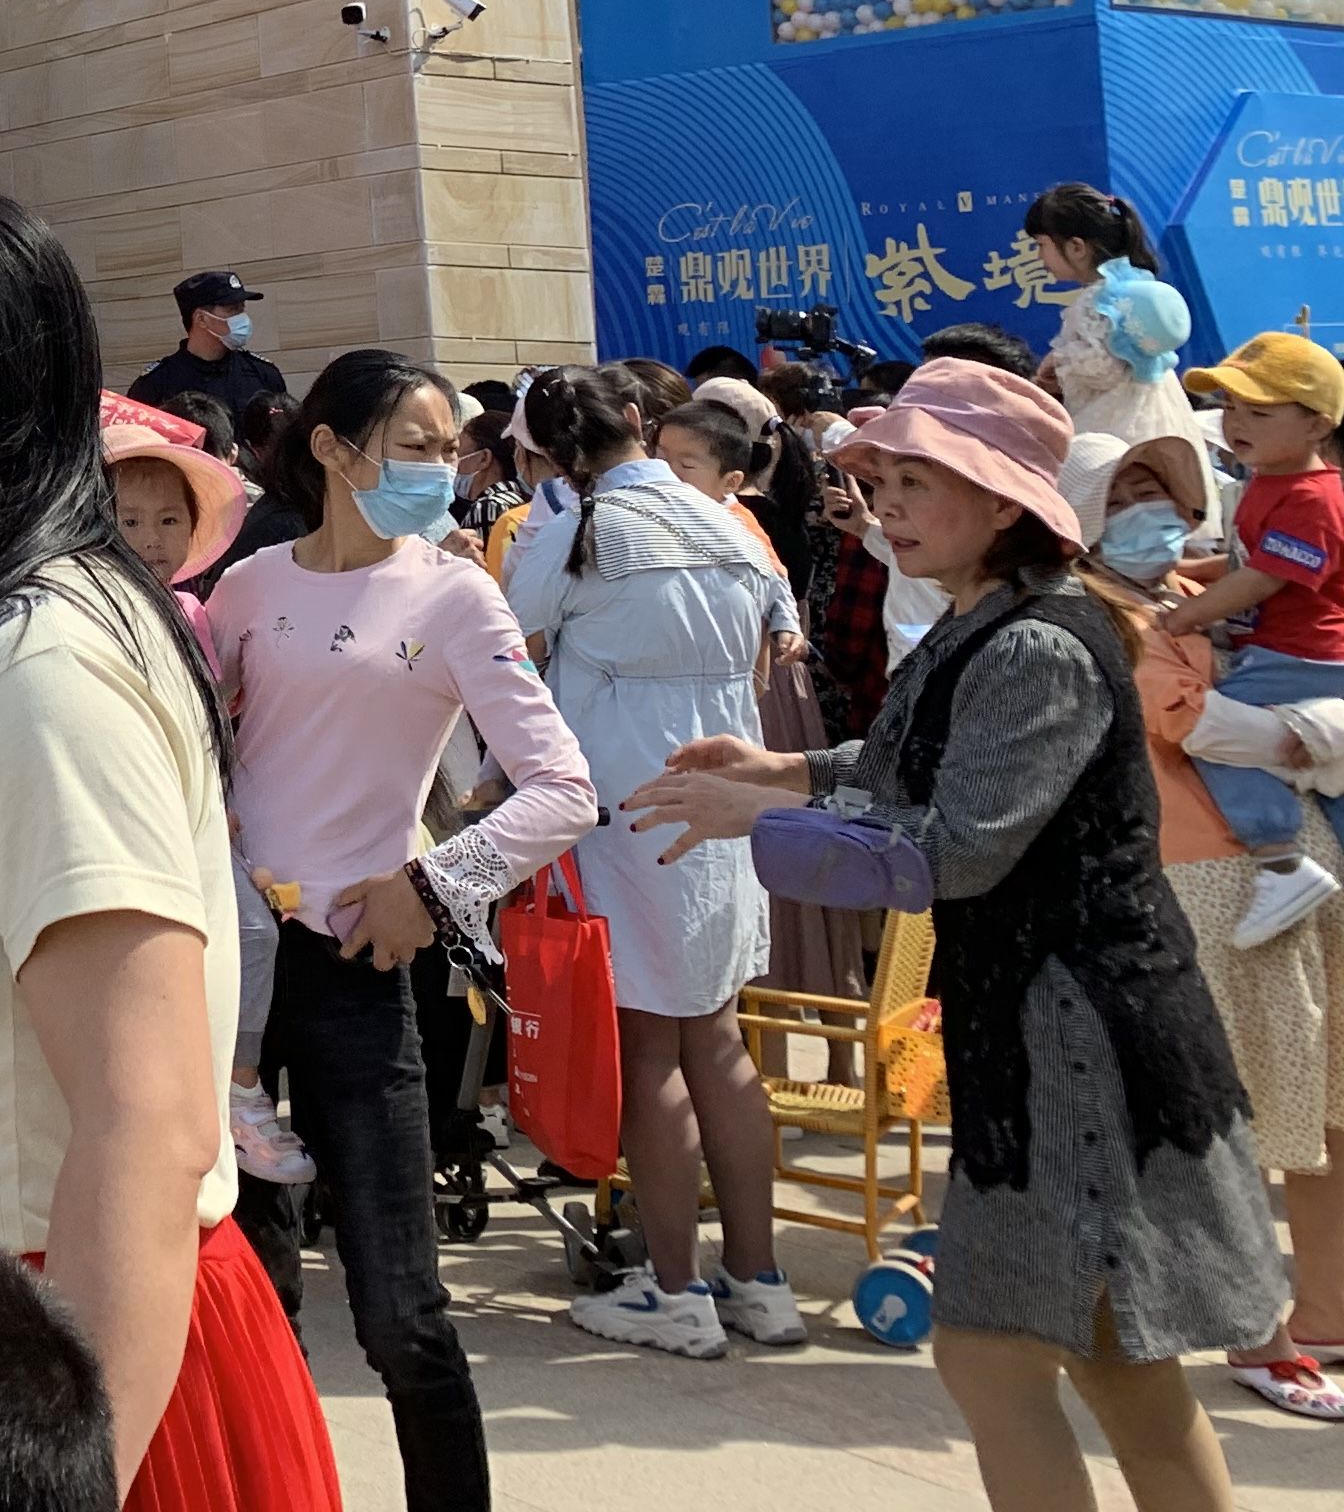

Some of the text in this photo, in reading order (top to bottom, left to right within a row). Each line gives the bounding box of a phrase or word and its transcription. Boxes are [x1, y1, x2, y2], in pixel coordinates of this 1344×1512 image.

[860, 199, 947, 217] ROYAL
[1257, 175, 1344, 228] 鼎观世
[678, 242, 832, 305] 鼎观世界
[864, 222, 1082, 324] 紫境
